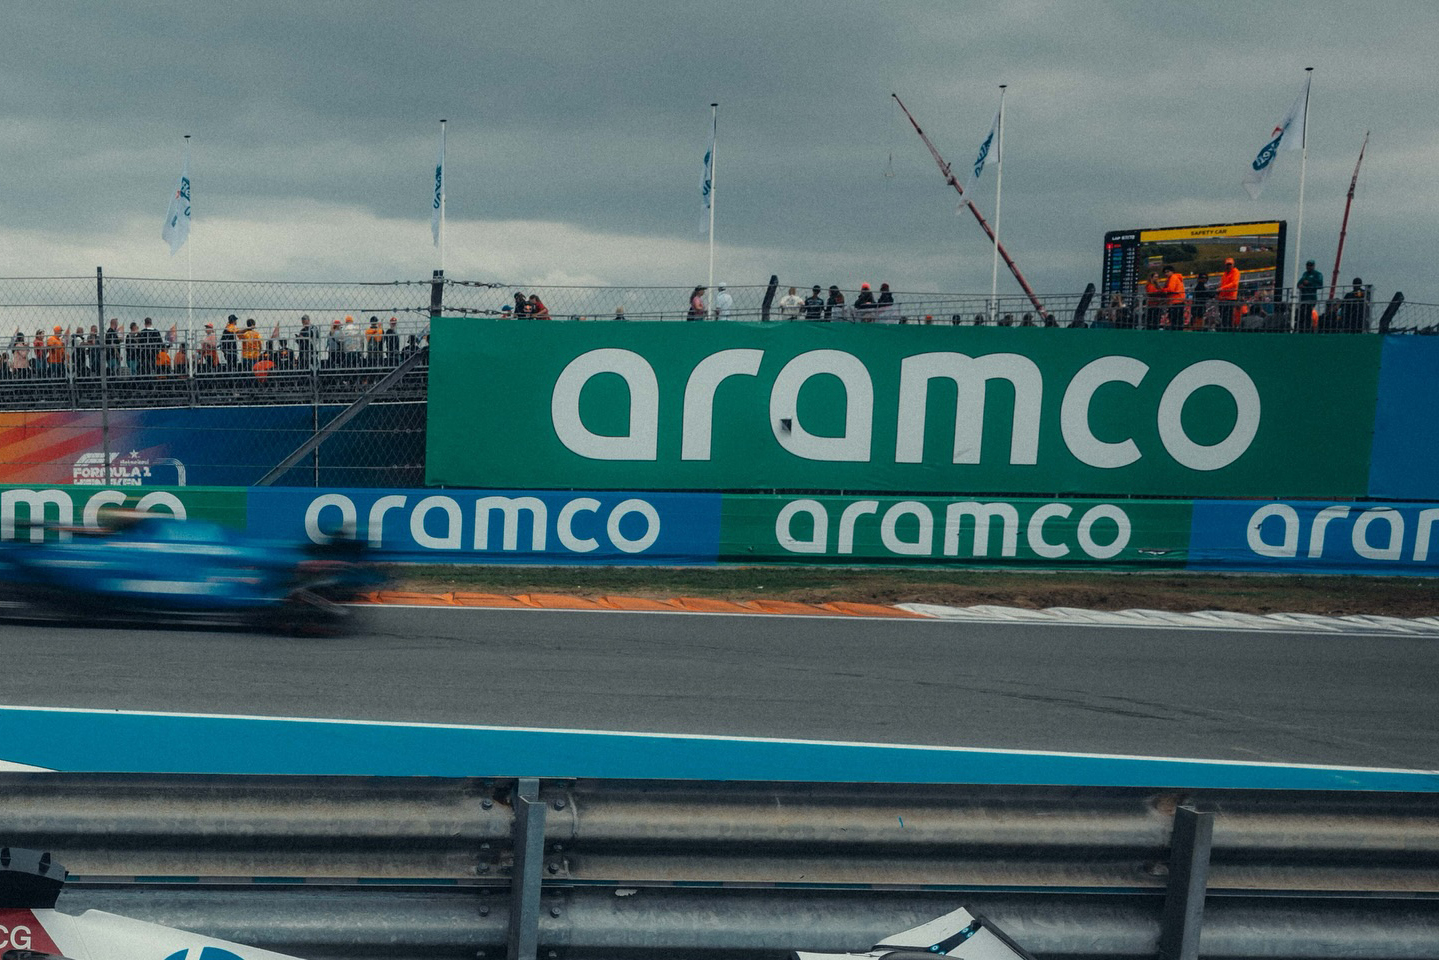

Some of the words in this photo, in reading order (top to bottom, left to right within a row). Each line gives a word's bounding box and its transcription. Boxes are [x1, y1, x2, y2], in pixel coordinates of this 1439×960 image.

[552, 348, 1260, 470] aramco
[73, 466, 142, 478] FORMULA
[143, 466, 152, 477] 1
[305, 493, 660, 553] aramco
[776, 499, 1131, 559] aramco
